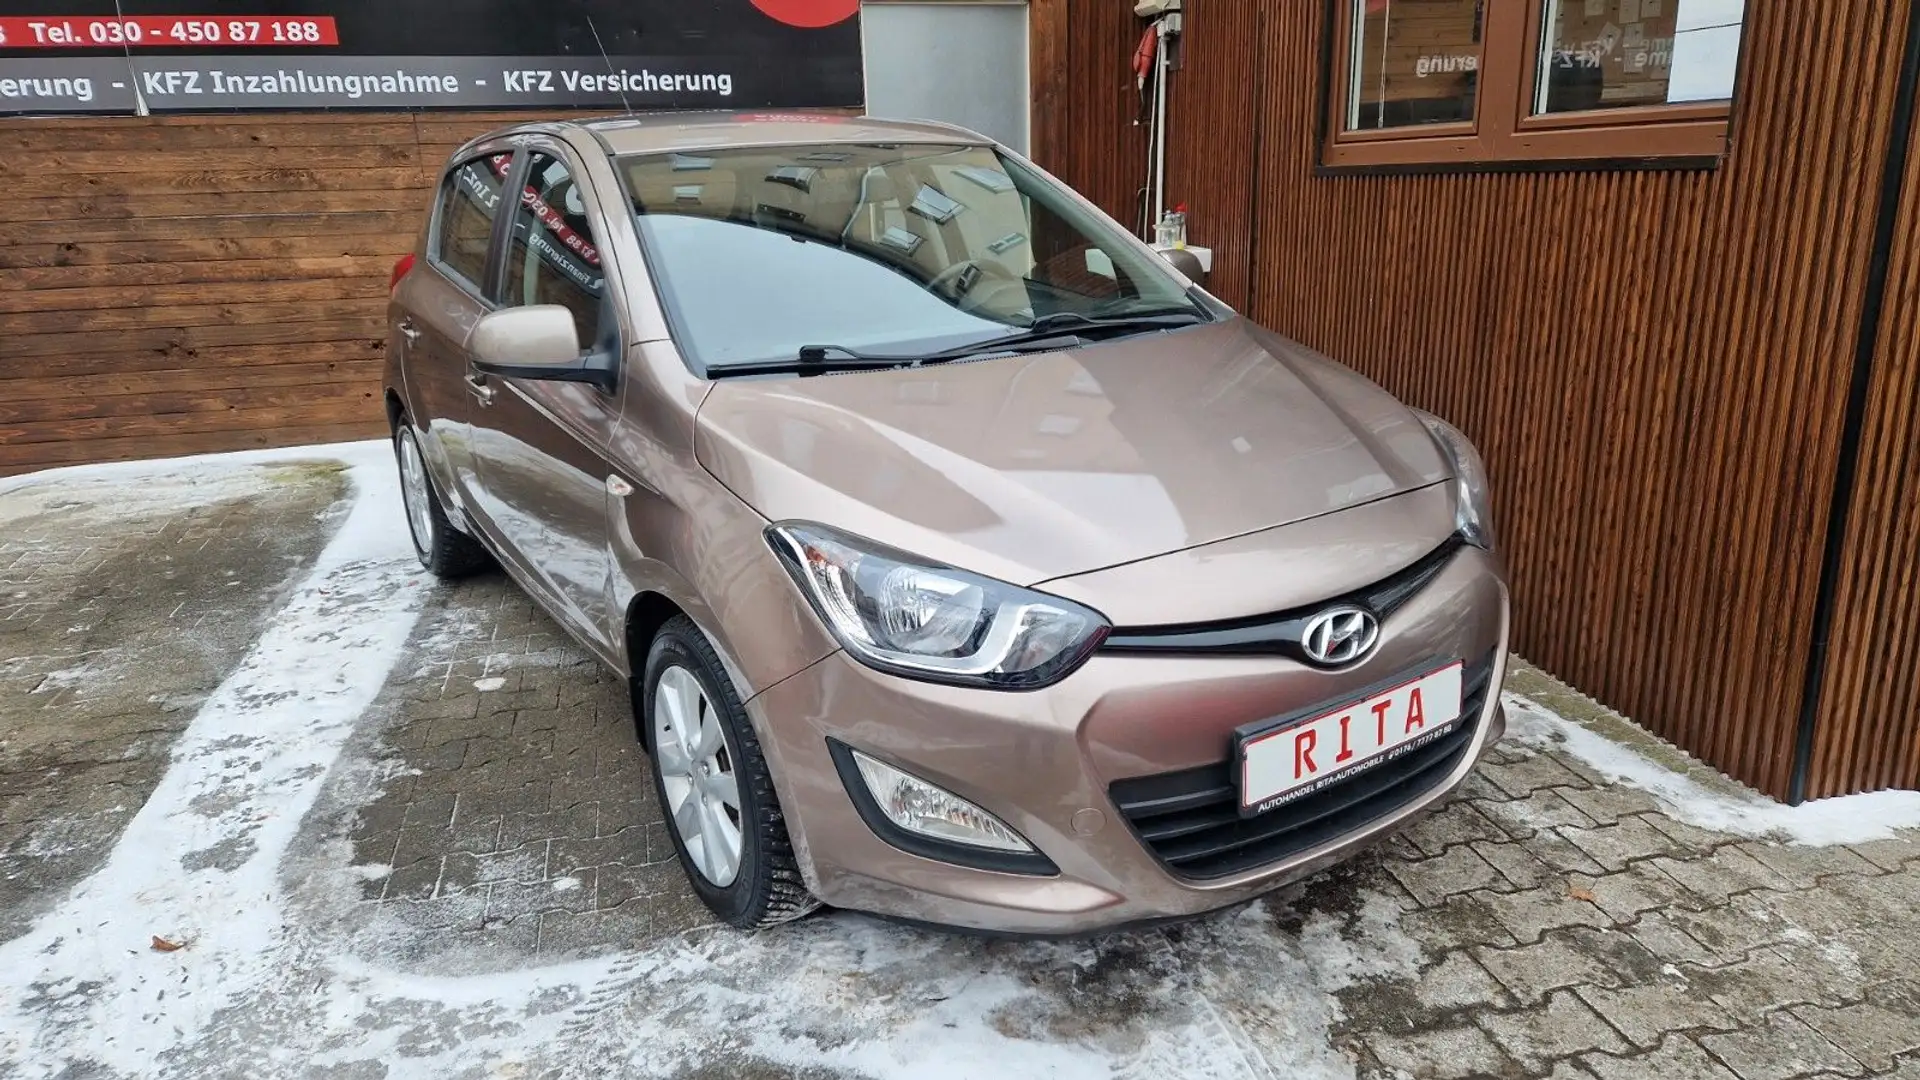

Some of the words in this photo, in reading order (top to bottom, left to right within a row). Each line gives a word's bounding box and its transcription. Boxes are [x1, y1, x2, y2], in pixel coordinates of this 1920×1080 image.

[27, 21, 82, 43] Tel.
[89, 21, 142, 43] 030
[170, 21, 221, 42] 450
[228, 21, 260, 42] 87
[272, 21, 320, 42] 188
[0, 77, 93, 102] erung
[143, 71, 203, 95] KFZ
[210, 69, 459, 99] Inzahlungnahme
[503, 70, 555, 93] KFZ
[561, 69, 733, 96] Versicherung
[1293, 687, 1425, 780] RITA
[1257, 784, 1316, 813] AUTOHANDEL
[1316, 754, 1385, 790] RITA-AUTOMOBILE
